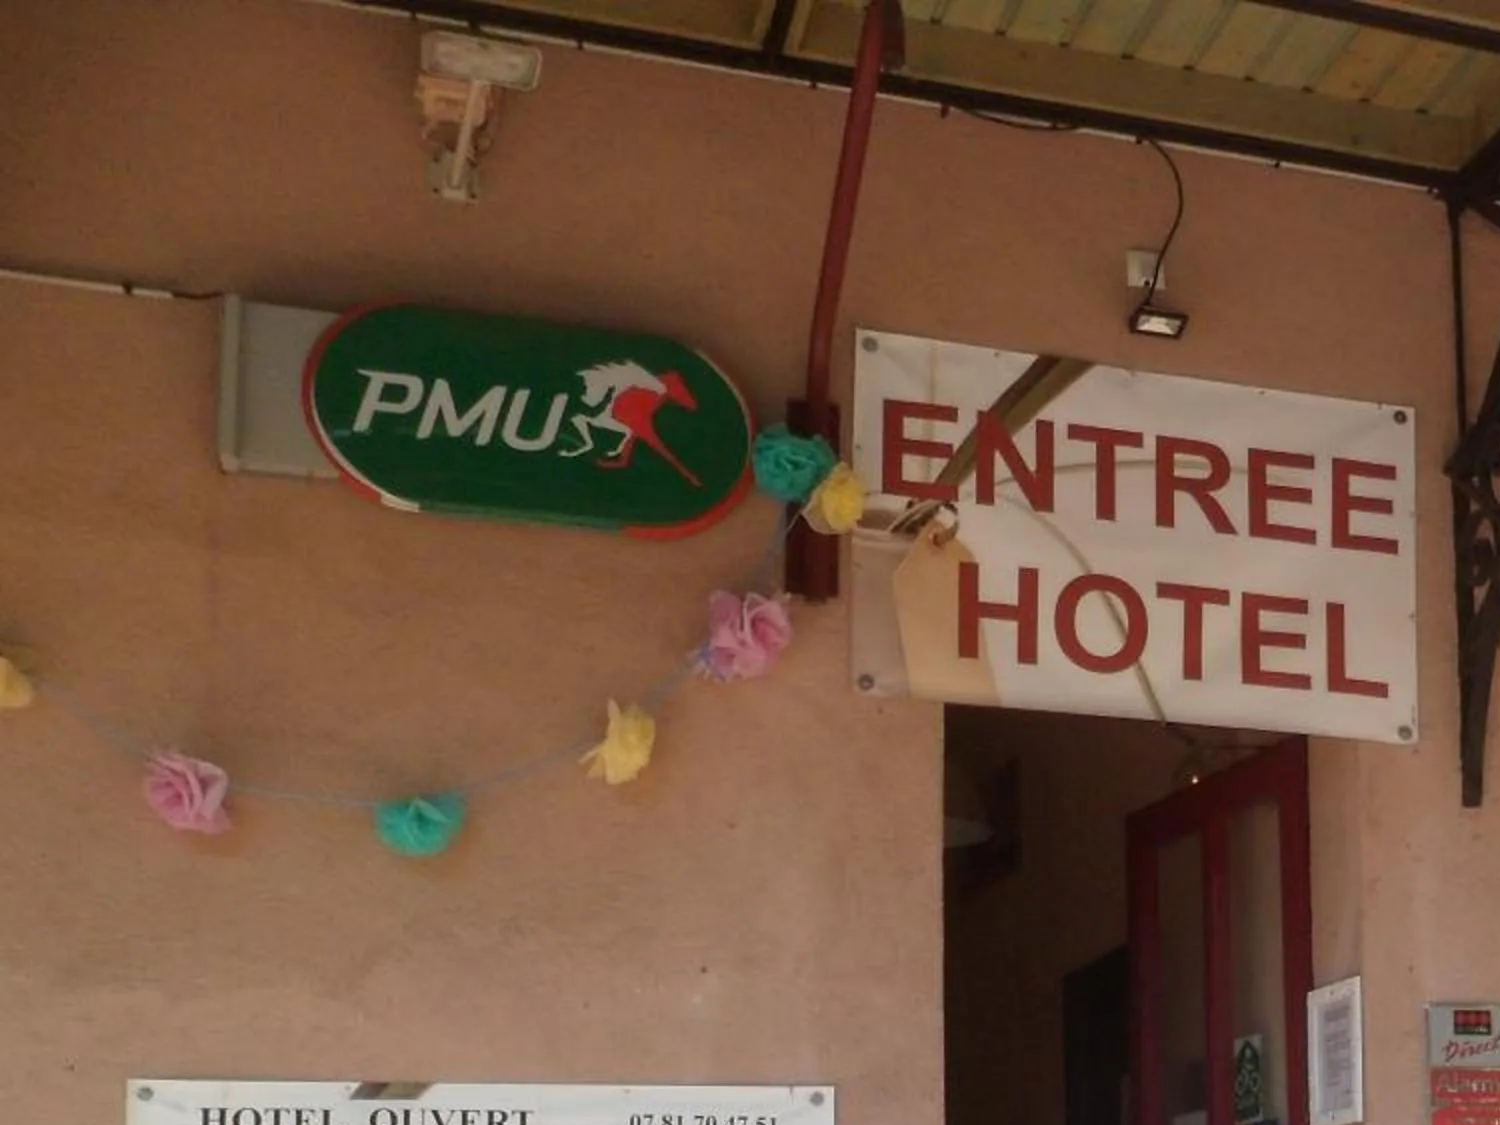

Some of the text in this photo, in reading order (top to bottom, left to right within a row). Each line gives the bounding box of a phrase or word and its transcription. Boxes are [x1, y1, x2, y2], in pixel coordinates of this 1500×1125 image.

[356, 367, 569, 452] PMU
[880, 398, 1399, 556] ENTREE
[957, 560, 1390, 699] HOTEL
